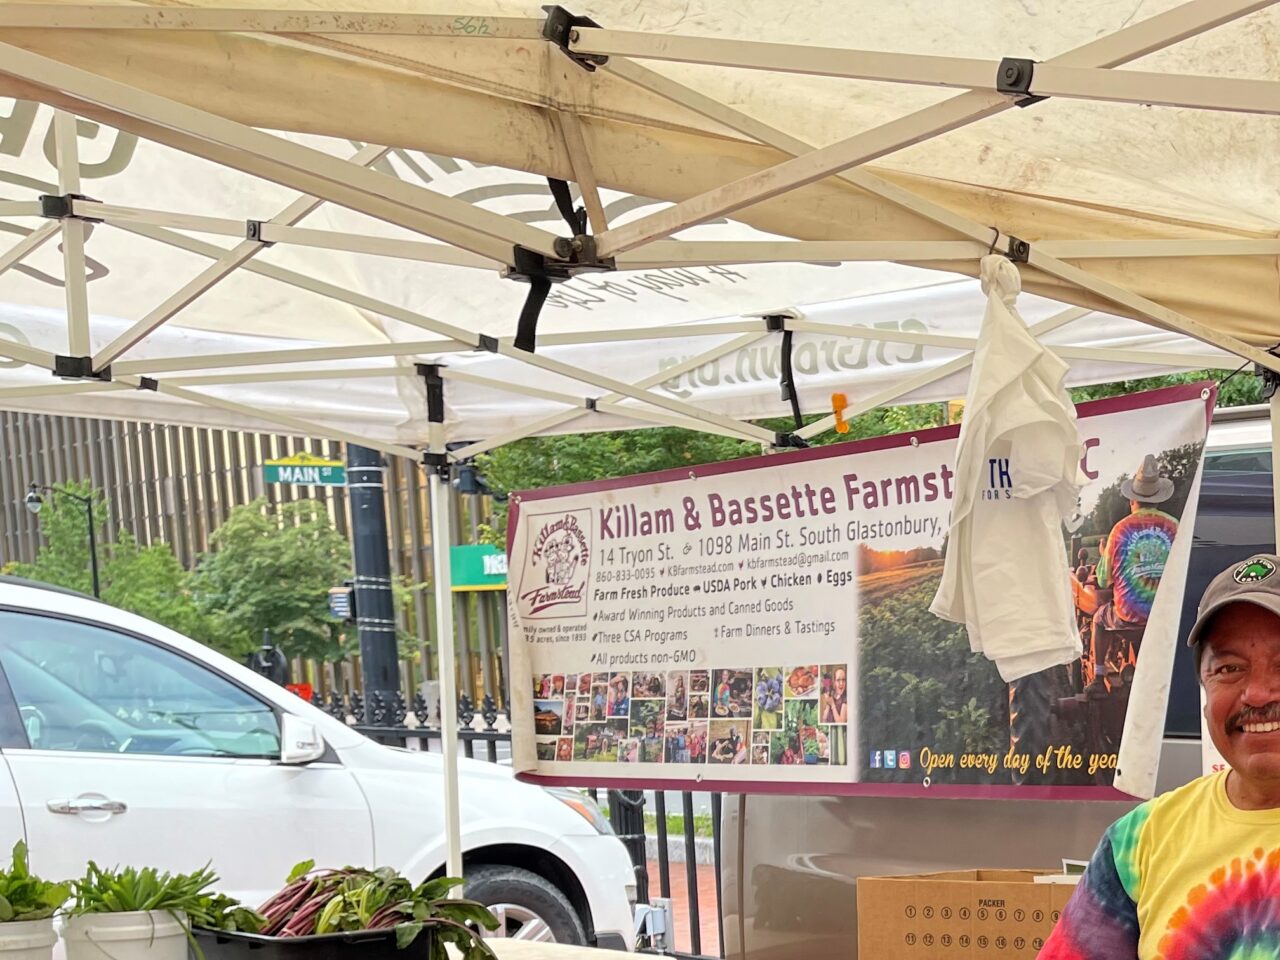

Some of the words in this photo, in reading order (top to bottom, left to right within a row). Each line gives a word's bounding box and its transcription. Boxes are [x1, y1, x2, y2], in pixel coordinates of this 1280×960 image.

[278, 466, 320, 482] MAIN
[600, 503, 675, 541] Killam
[683, 495, 702, 531] &
[708, 483, 836, 528] Bassette
[843, 463, 954, 511] Farmst
[600, 548, 614, 566] 14
[619, 545, 653, 568] Tryon
[657, 542, 674, 561] St.
[698, 535, 732, 557] 1098
[738, 533, 771, 552] Main
[775, 530, 794, 549] St.
[799, 523, 840, 547] South
[846, 514, 943, 542] Glastonbury,
[747, 550, 849, 570] kbfarmstead@gmail.com
[521, 581, 586, 606] Farmstead
[594, 588, 618, 602] Farm
[621, 586, 648, 600] Fresh
[650, 584, 690, 598] Produce
[703, 579, 731, 593] USDA
[733, 577, 758, 592] Pork
[770, 573, 812, 589] Chicken
[826, 570, 852, 586] Eggs
[598, 608, 626, 623] Award
[628, 607, 665, 624] Winning
[667, 604, 706, 619] Products
[709, 603, 725, 617] and
[728, 600, 762, 616] Canned
[764, 598, 794, 613] Goods
[598, 629, 622, 644] Three
[623, 628, 642, 642] CSA
[643, 628, 688, 645] Programs
[720, 624, 744, 639] Farm
[746, 623, 783, 638] Dinners
[784, 621, 791, 635] &
[794, 619, 836, 638] Tastings
[596, 652, 608, 665] All
[609, 651, 649, 667] products
[651, 649, 697, 664] non-GMO
[919, 746, 955, 775] Open
[960, 753, 998, 773] every
[1003, 746, 1030, 774] day
[1035, 745, 1053, 774] of
[1054, 745, 1082, 769] the
[1088, 754, 1118, 775] yea
[979, 899, 1005, 908] PACKER
